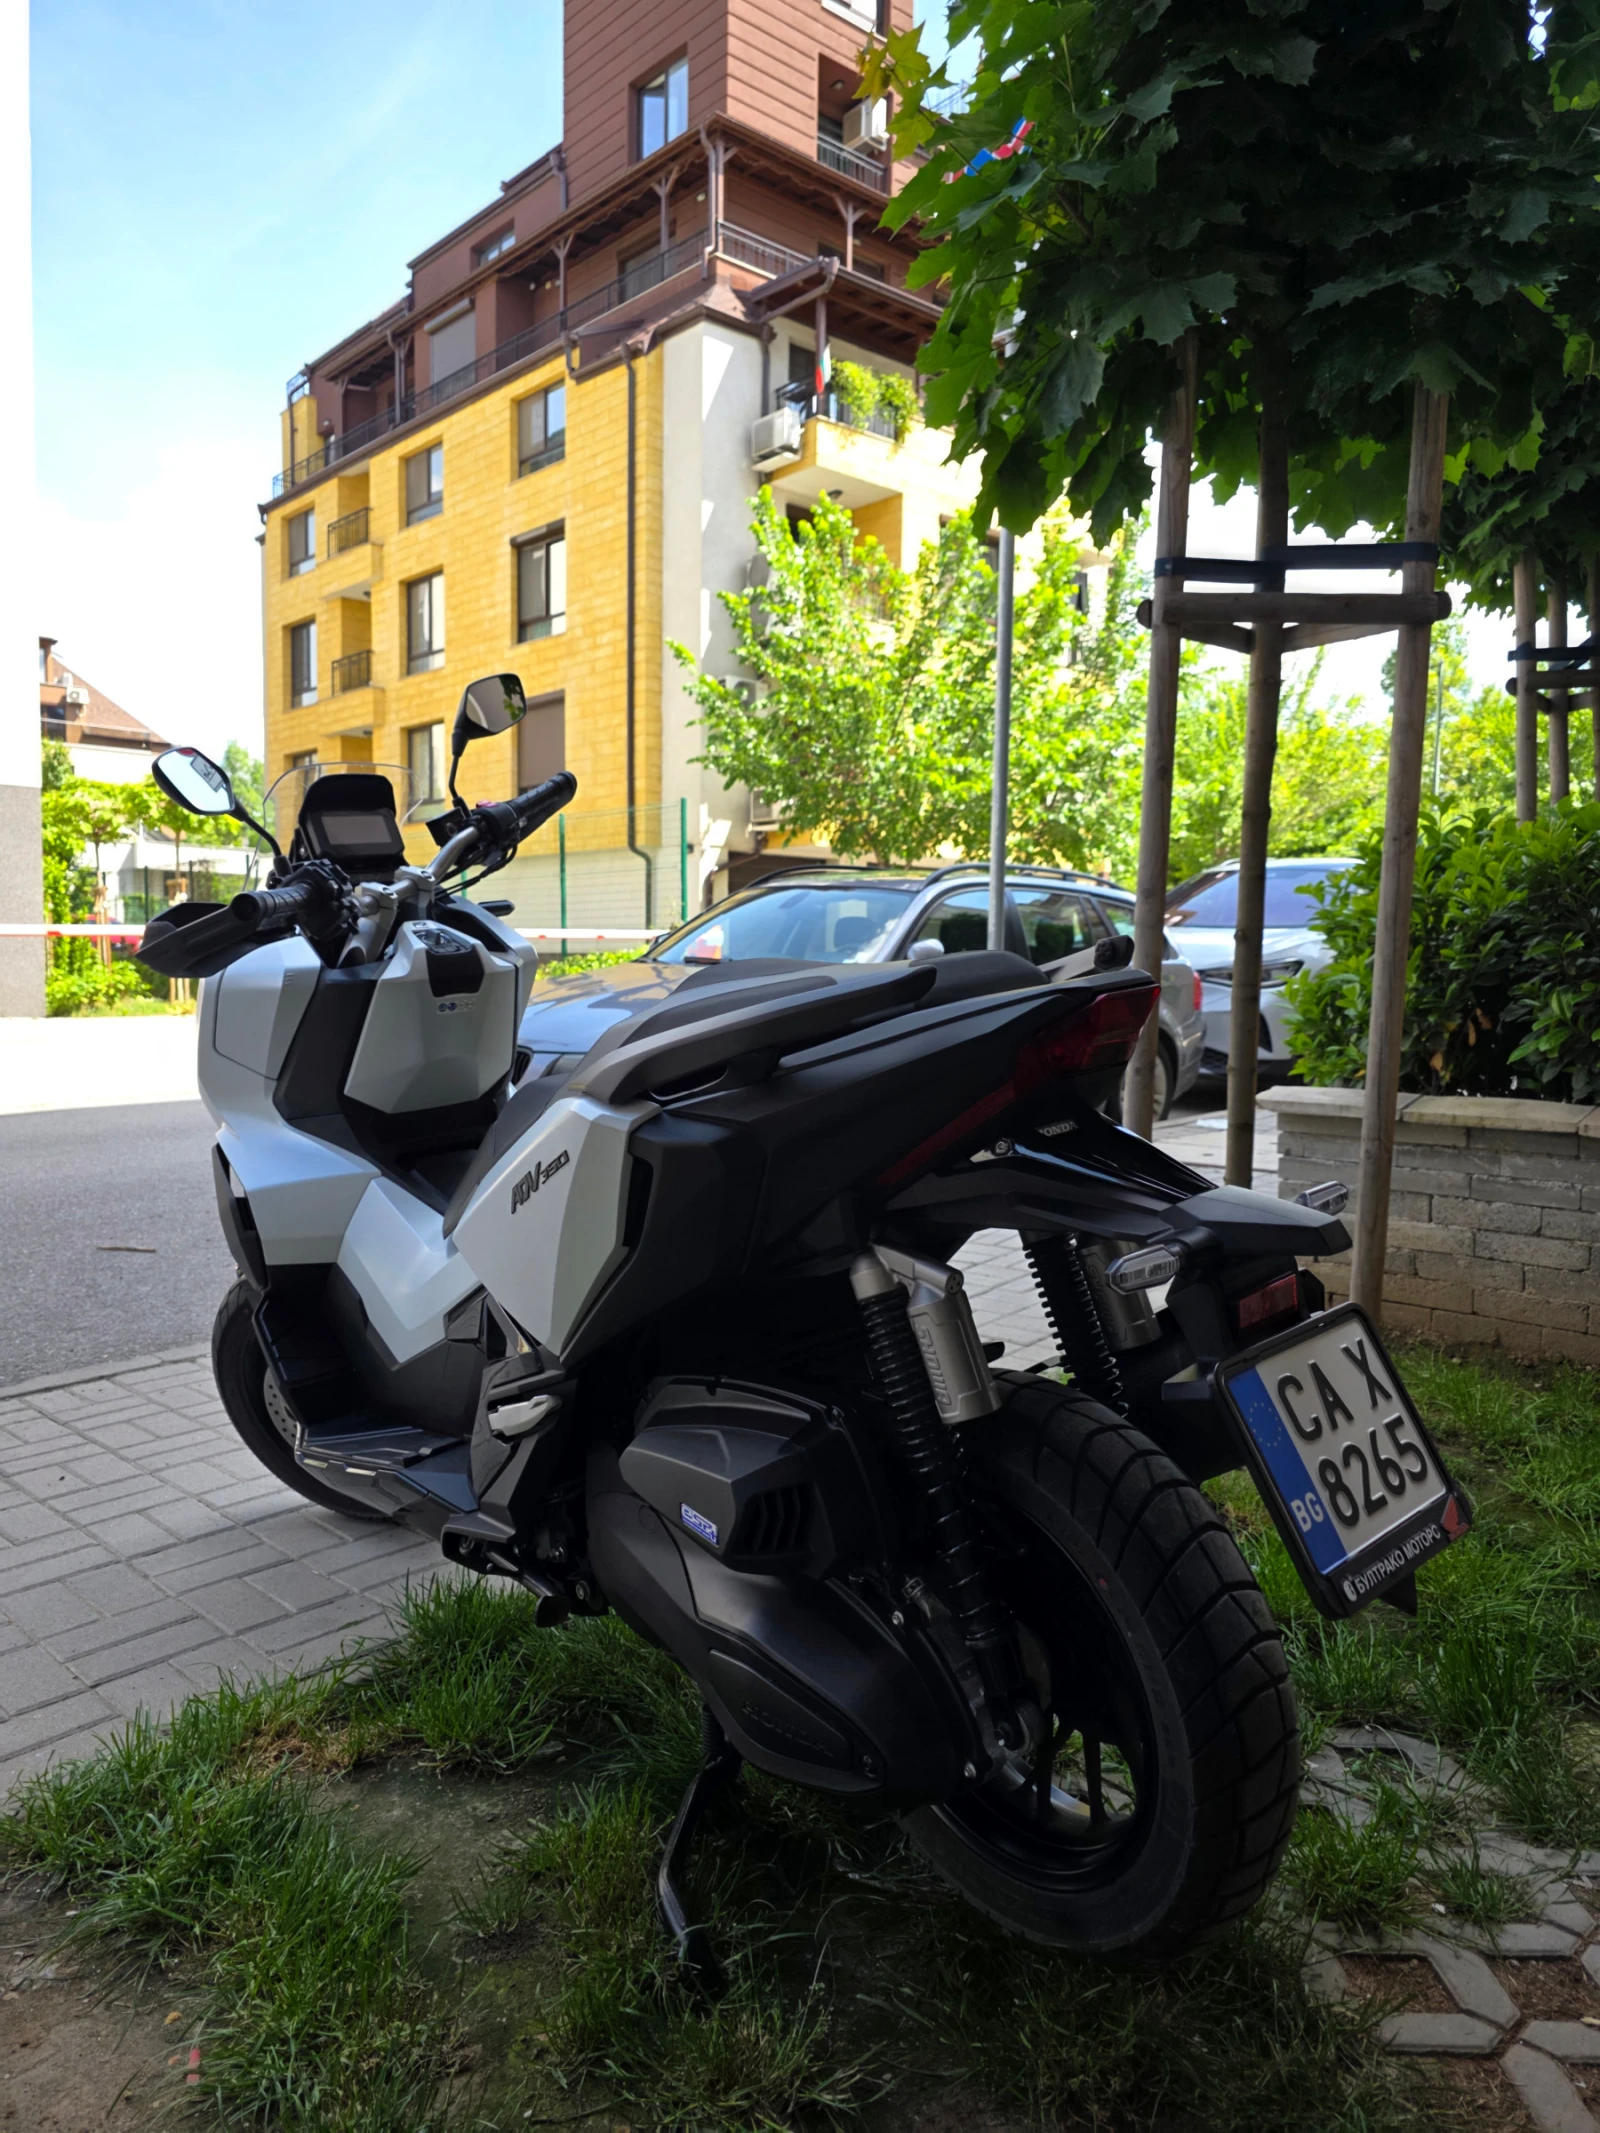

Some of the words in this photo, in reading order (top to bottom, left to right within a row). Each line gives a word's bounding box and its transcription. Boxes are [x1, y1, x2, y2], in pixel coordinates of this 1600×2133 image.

[1318, 1413, 1428, 1528] 8265
[1290, 1492, 1324, 1533] BG
[1402, 1524, 1441, 1560] МОТОРС
